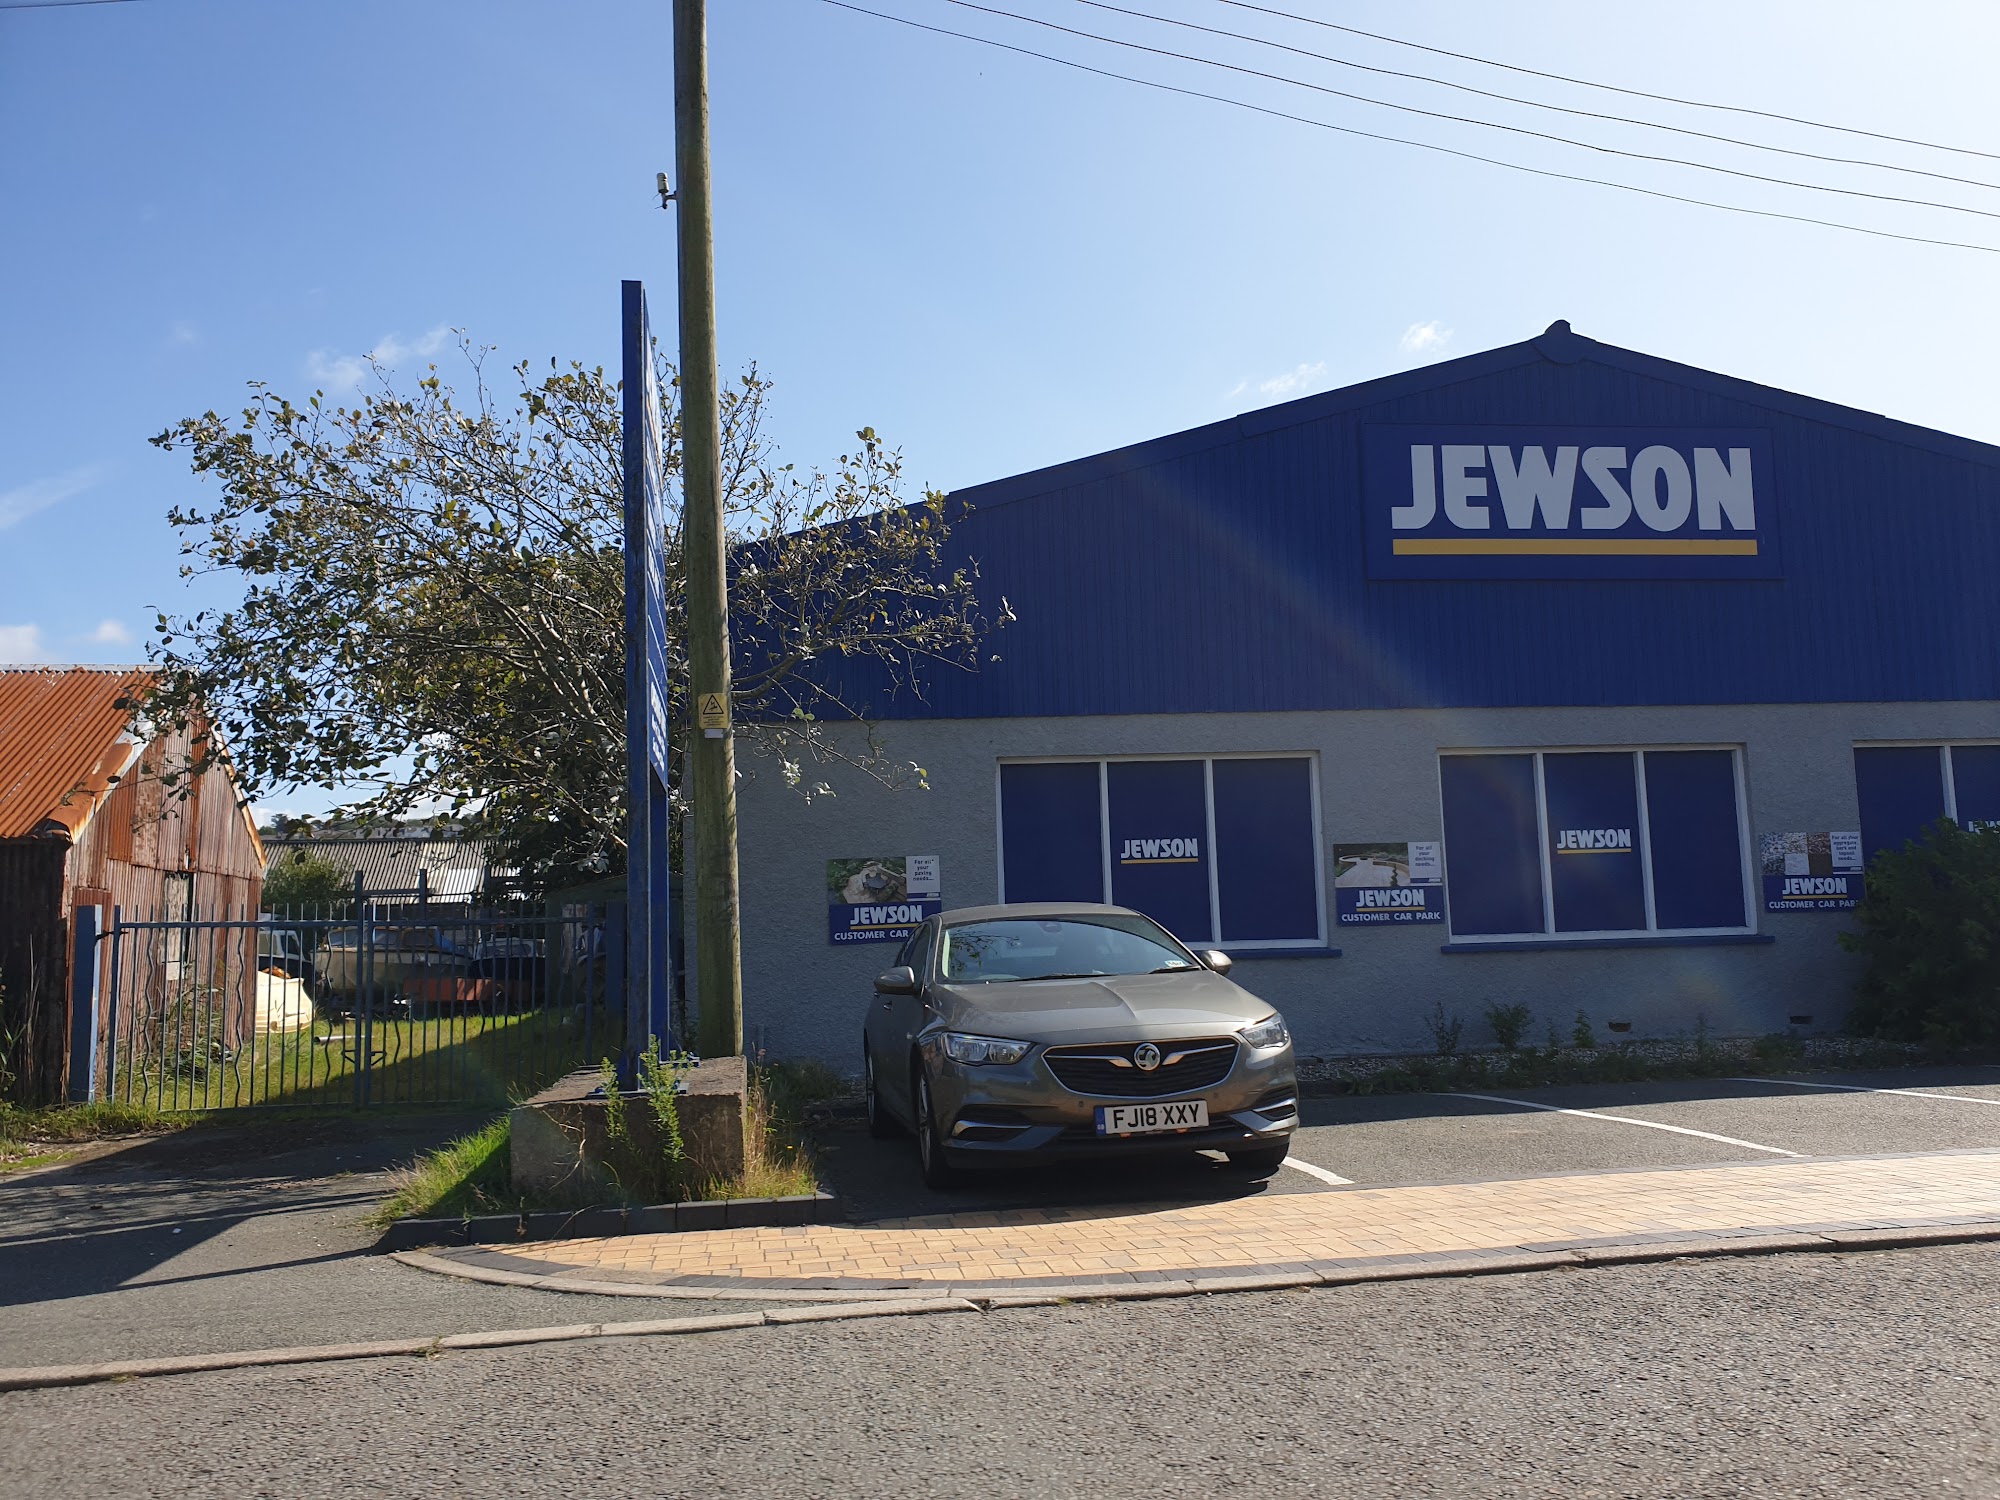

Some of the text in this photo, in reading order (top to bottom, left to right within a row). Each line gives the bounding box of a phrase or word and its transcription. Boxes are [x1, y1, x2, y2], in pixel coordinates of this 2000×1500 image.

[1391, 444, 1756, 532] JEWSON
[1120, 837, 1199, 859] JEWSON
[1556, 828, 1632, 849] JEWSON
[1782, 877, 1848, 895] JEWSON
[1355, 888, 1425, 908] JEWSON
[1768, 899, 1859, 909] CUSTOMER CAR PAR
[850, 904, 923, 925] JEWSON
[1341, 911, 1441, 922] CUSTOMER CAR PARK
[834, 929, 909, 941] CUSTOMER CAR
[1112, 1103, 1200, 1129] FJ18 XXY
